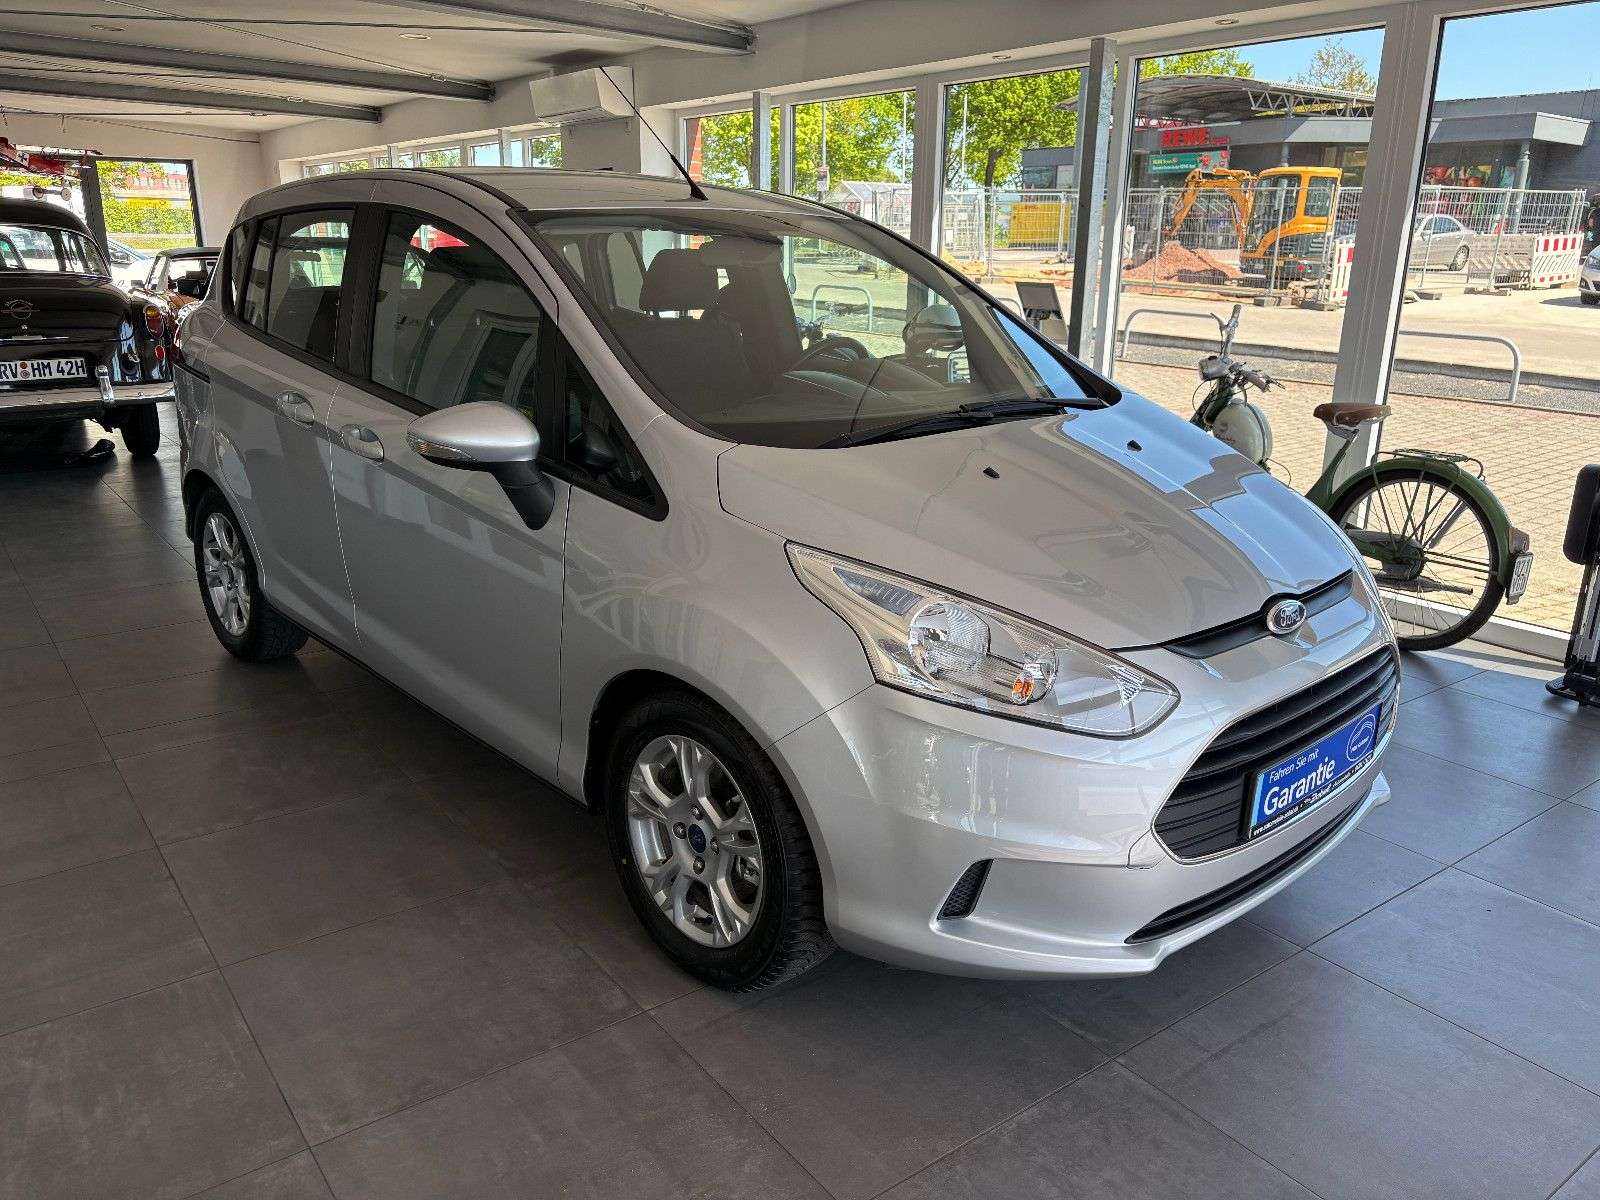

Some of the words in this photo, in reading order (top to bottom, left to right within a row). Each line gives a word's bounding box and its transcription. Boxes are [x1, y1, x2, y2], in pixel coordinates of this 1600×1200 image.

[1162, 127, 1210, 147] REWE
[31, 361, 52, 378] HM
[56, 360, 86, 376] 42H
[1269, 764, 1295, 783] Fahren
[1296, 756, 1307, 770] Sie
[1307, 748, 1320, 762] mit
[1263, 756, 1336, 815] Garantie
